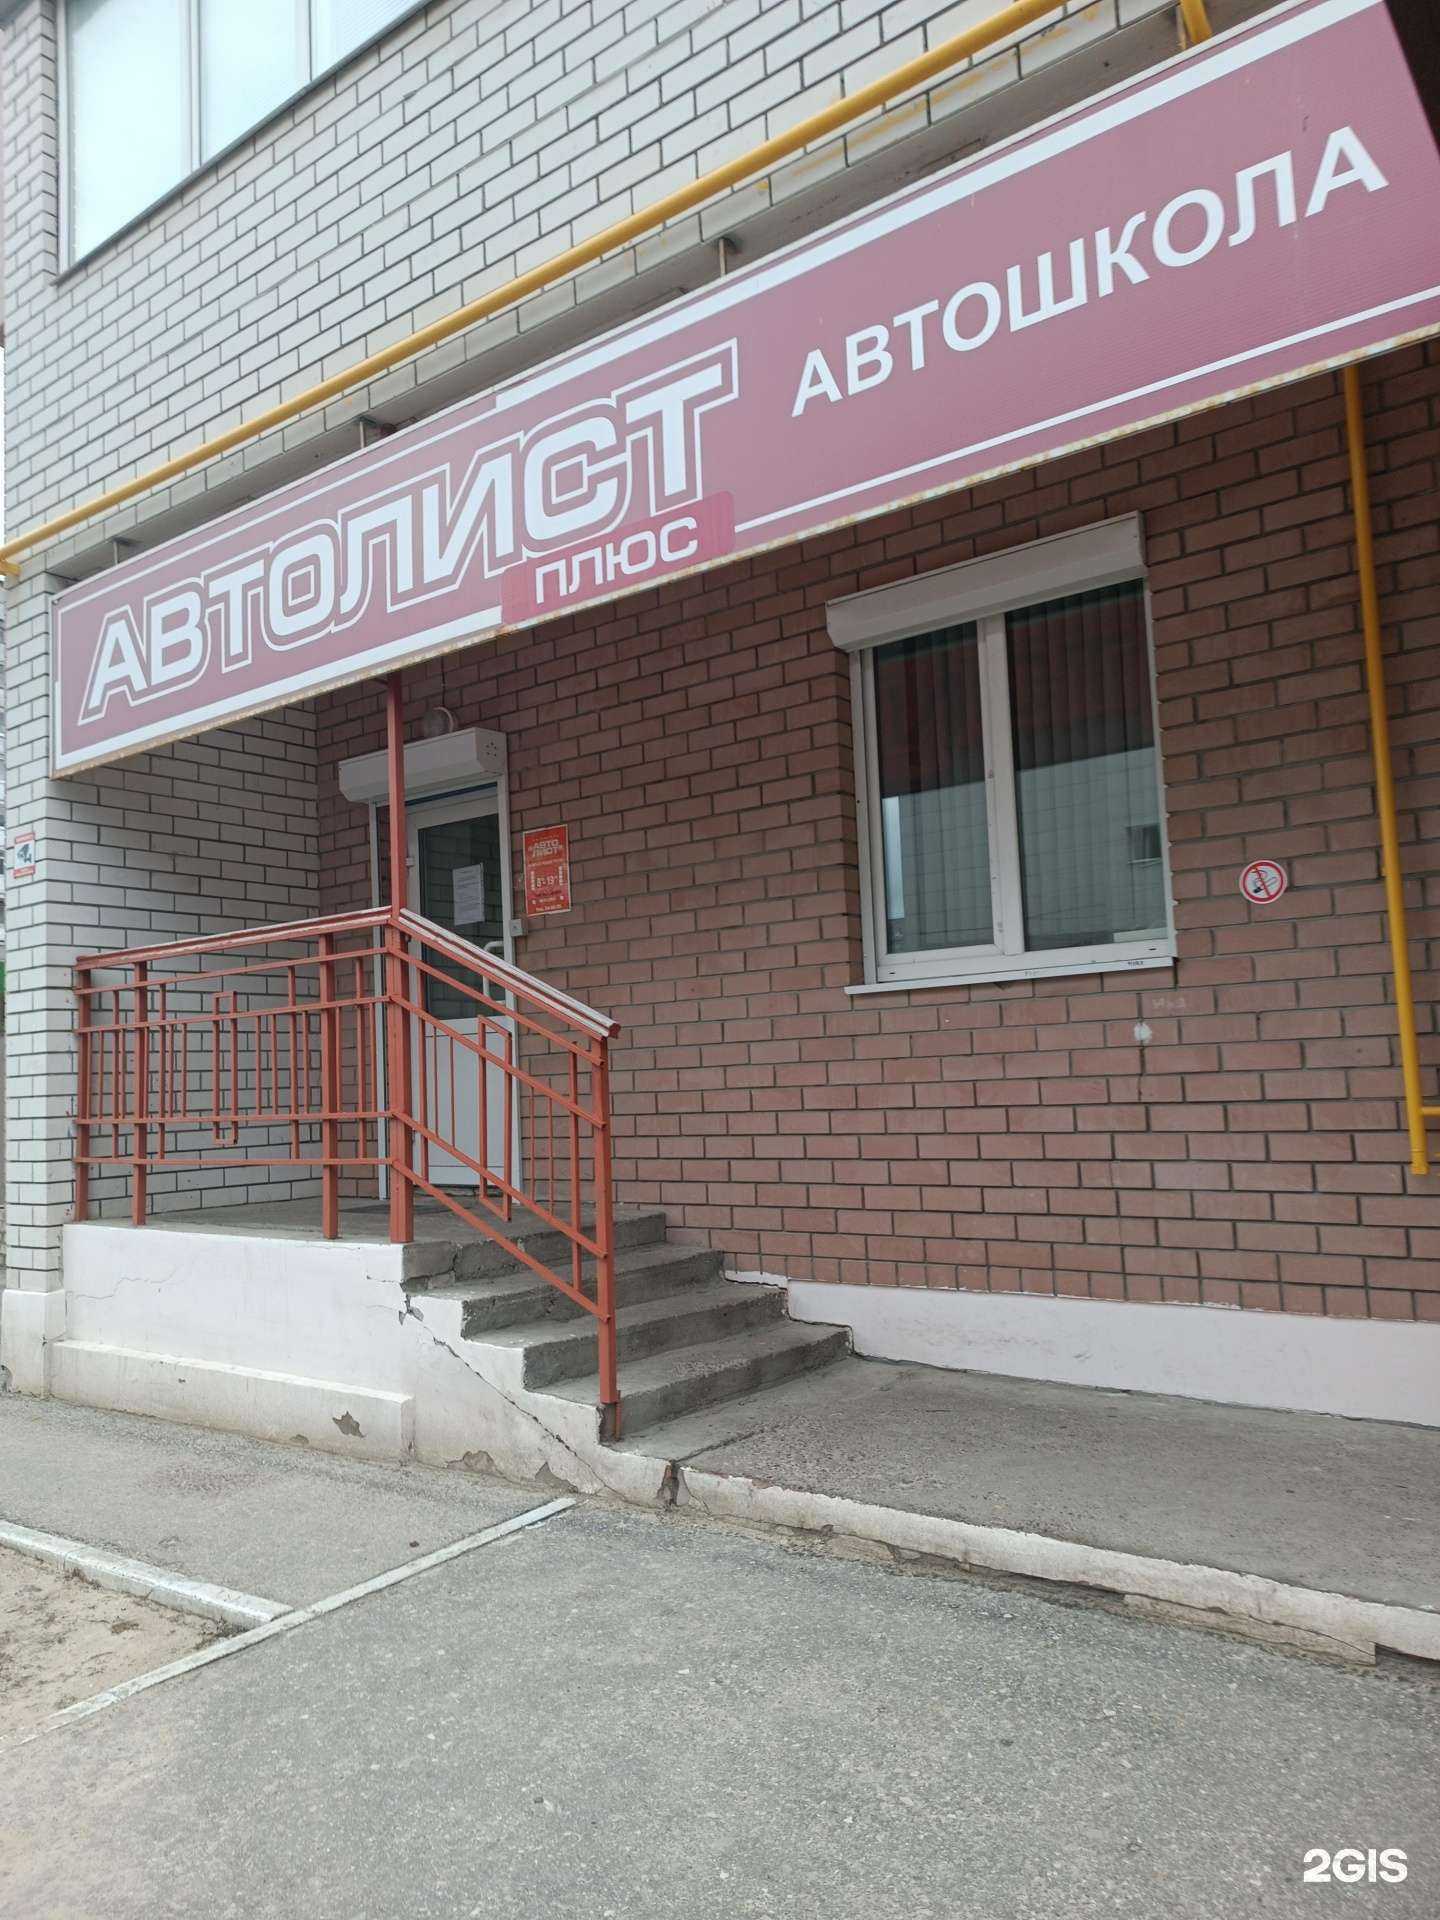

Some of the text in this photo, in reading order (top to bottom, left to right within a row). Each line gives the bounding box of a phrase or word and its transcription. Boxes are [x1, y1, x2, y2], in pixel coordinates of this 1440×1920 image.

[791, 126, 1389, 418] АВТОШКОЛА
[86, 360, 724, 713] АВТОЛИСТ
[535, 516, 698, 604] ПЛЮС
